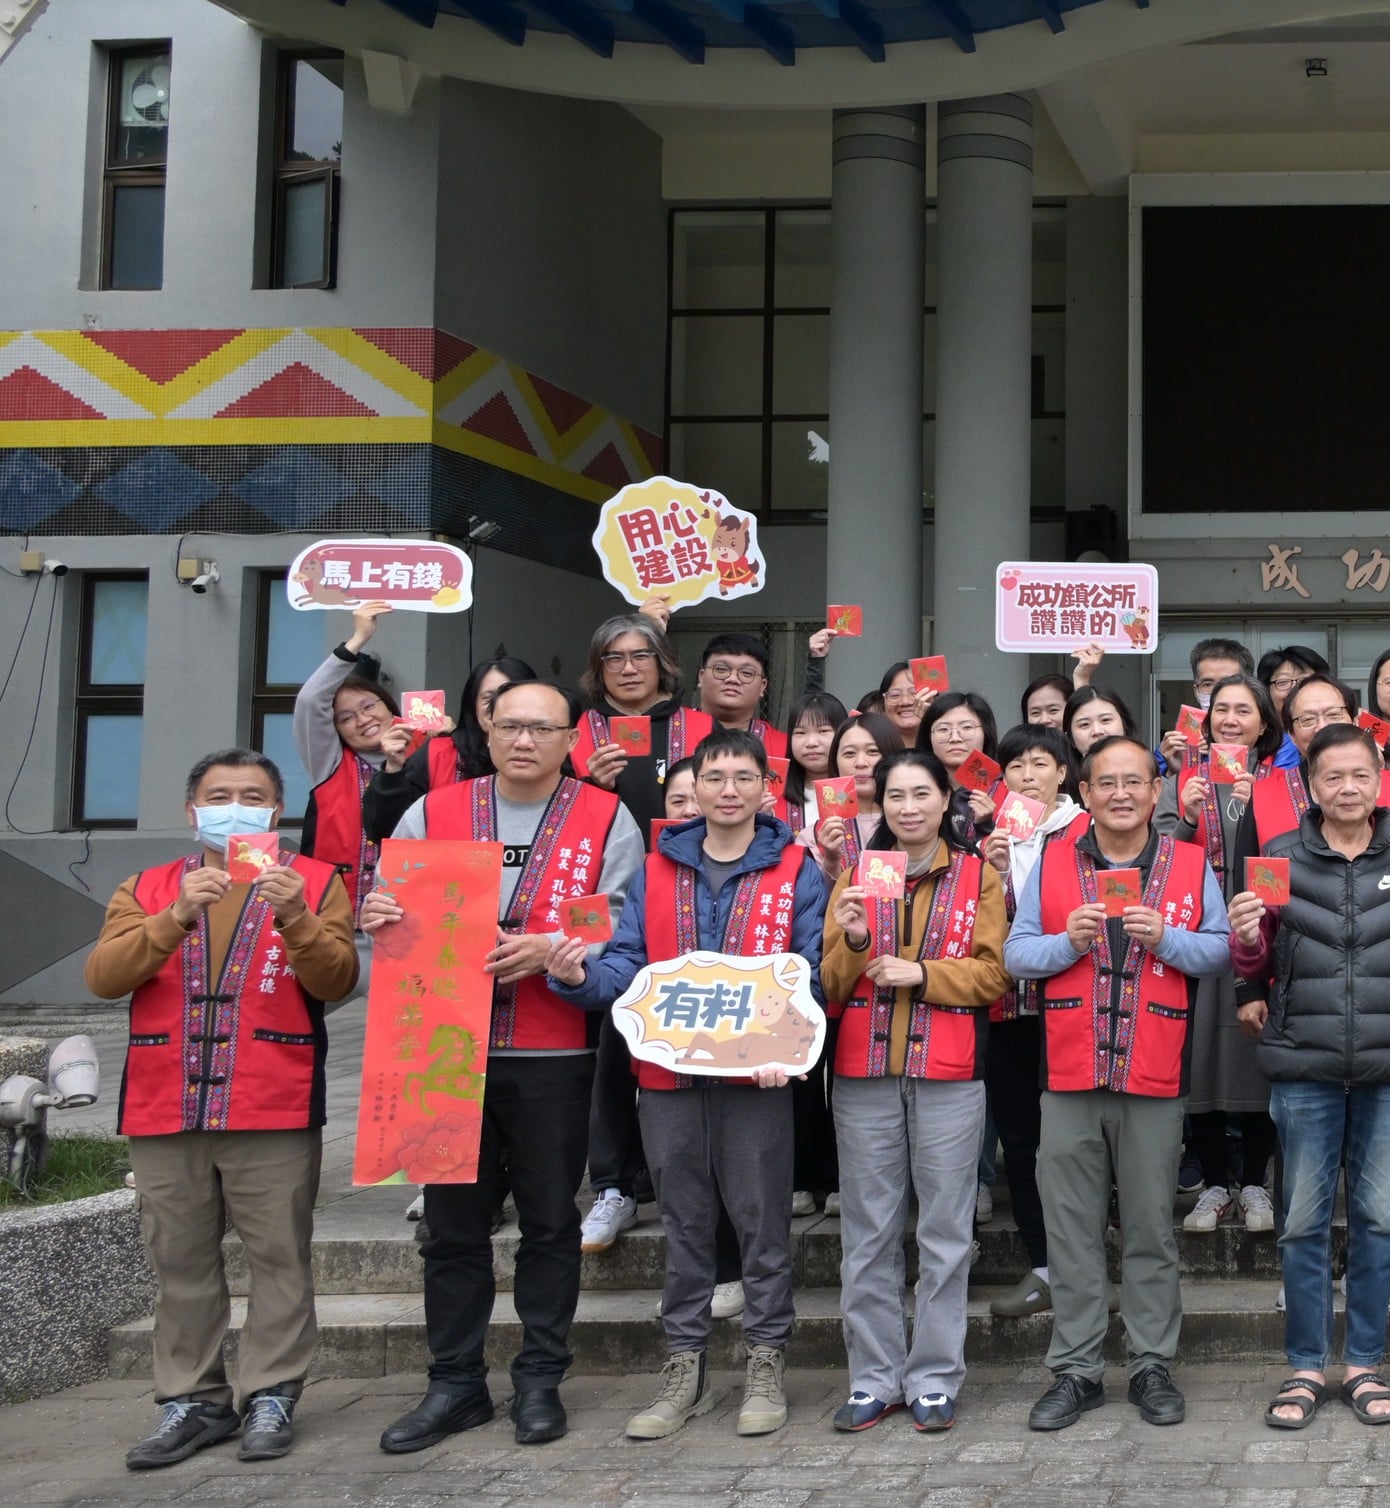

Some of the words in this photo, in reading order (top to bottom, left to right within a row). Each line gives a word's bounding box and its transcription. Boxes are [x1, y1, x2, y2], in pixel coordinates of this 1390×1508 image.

[618, 502, 698, 552] 用心
[320, 560, 443, 590] 馬上有錢
[633, 537, 713, 588] 建設
[1017, 582, 1136, 609] 成功鎮公所
[1031, 609, 1116, 636] 讚讚的
[558, 848, 572, 870] 課長
[760, 894, 773, 916] 課長
[770, 882, 793, 954] 成功鎮公所
[1164, 902, 1177, 925] 課長
[753, 924, 770, 956] 林昱
[259, 945, 281, 994] 古新德
[654, 981, 752, 1031] 有料
